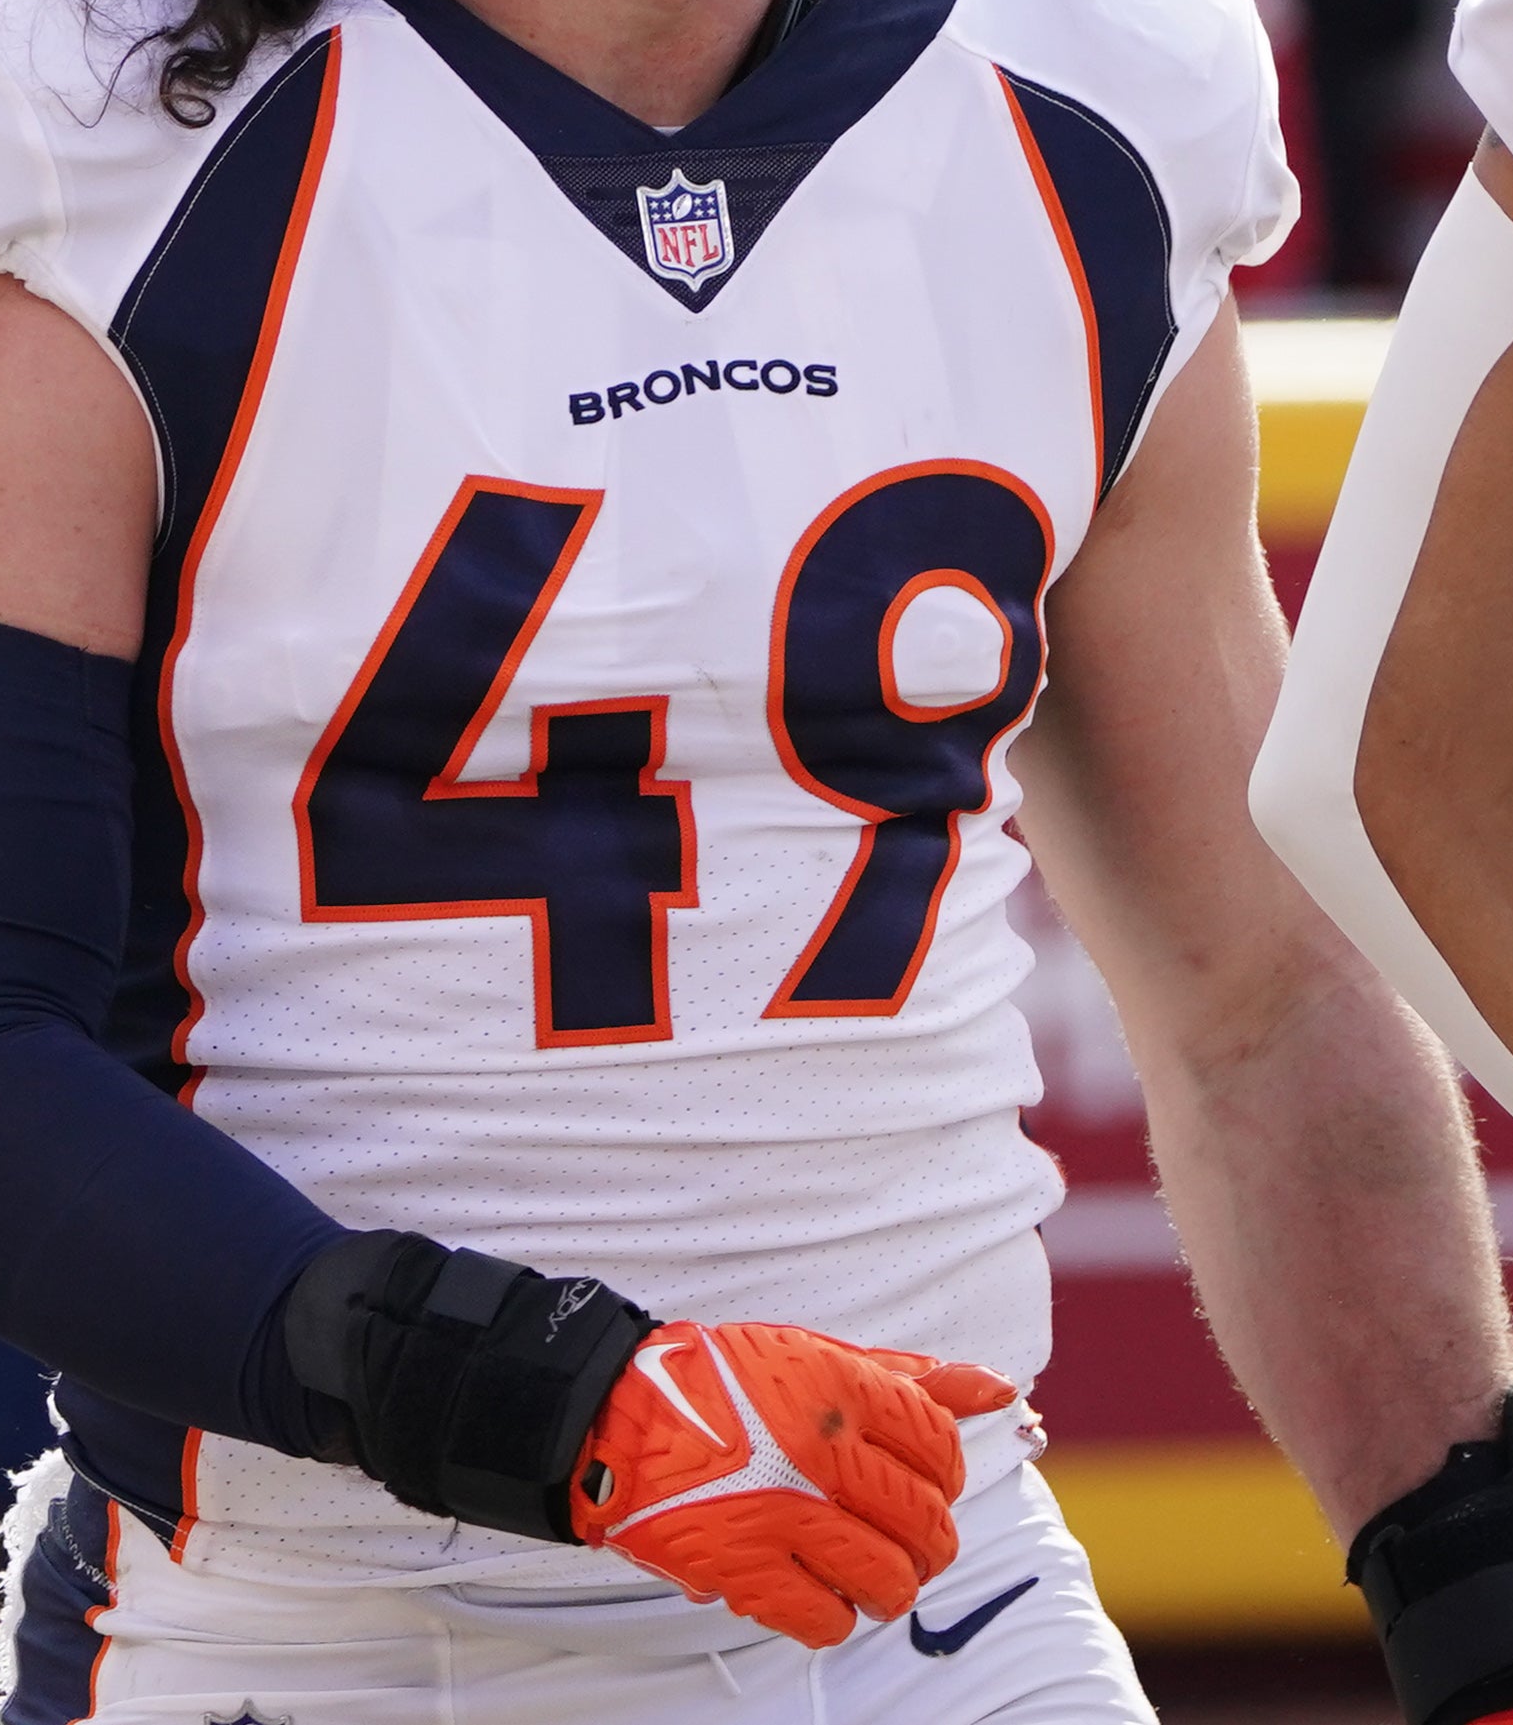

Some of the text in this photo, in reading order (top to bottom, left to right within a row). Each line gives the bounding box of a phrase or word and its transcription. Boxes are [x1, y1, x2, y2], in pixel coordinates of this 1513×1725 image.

[657, 223, 720, 268] NFL
[569, 359, 839, 425] BRONCOS
[292, 458, 1055, 1049] 49
